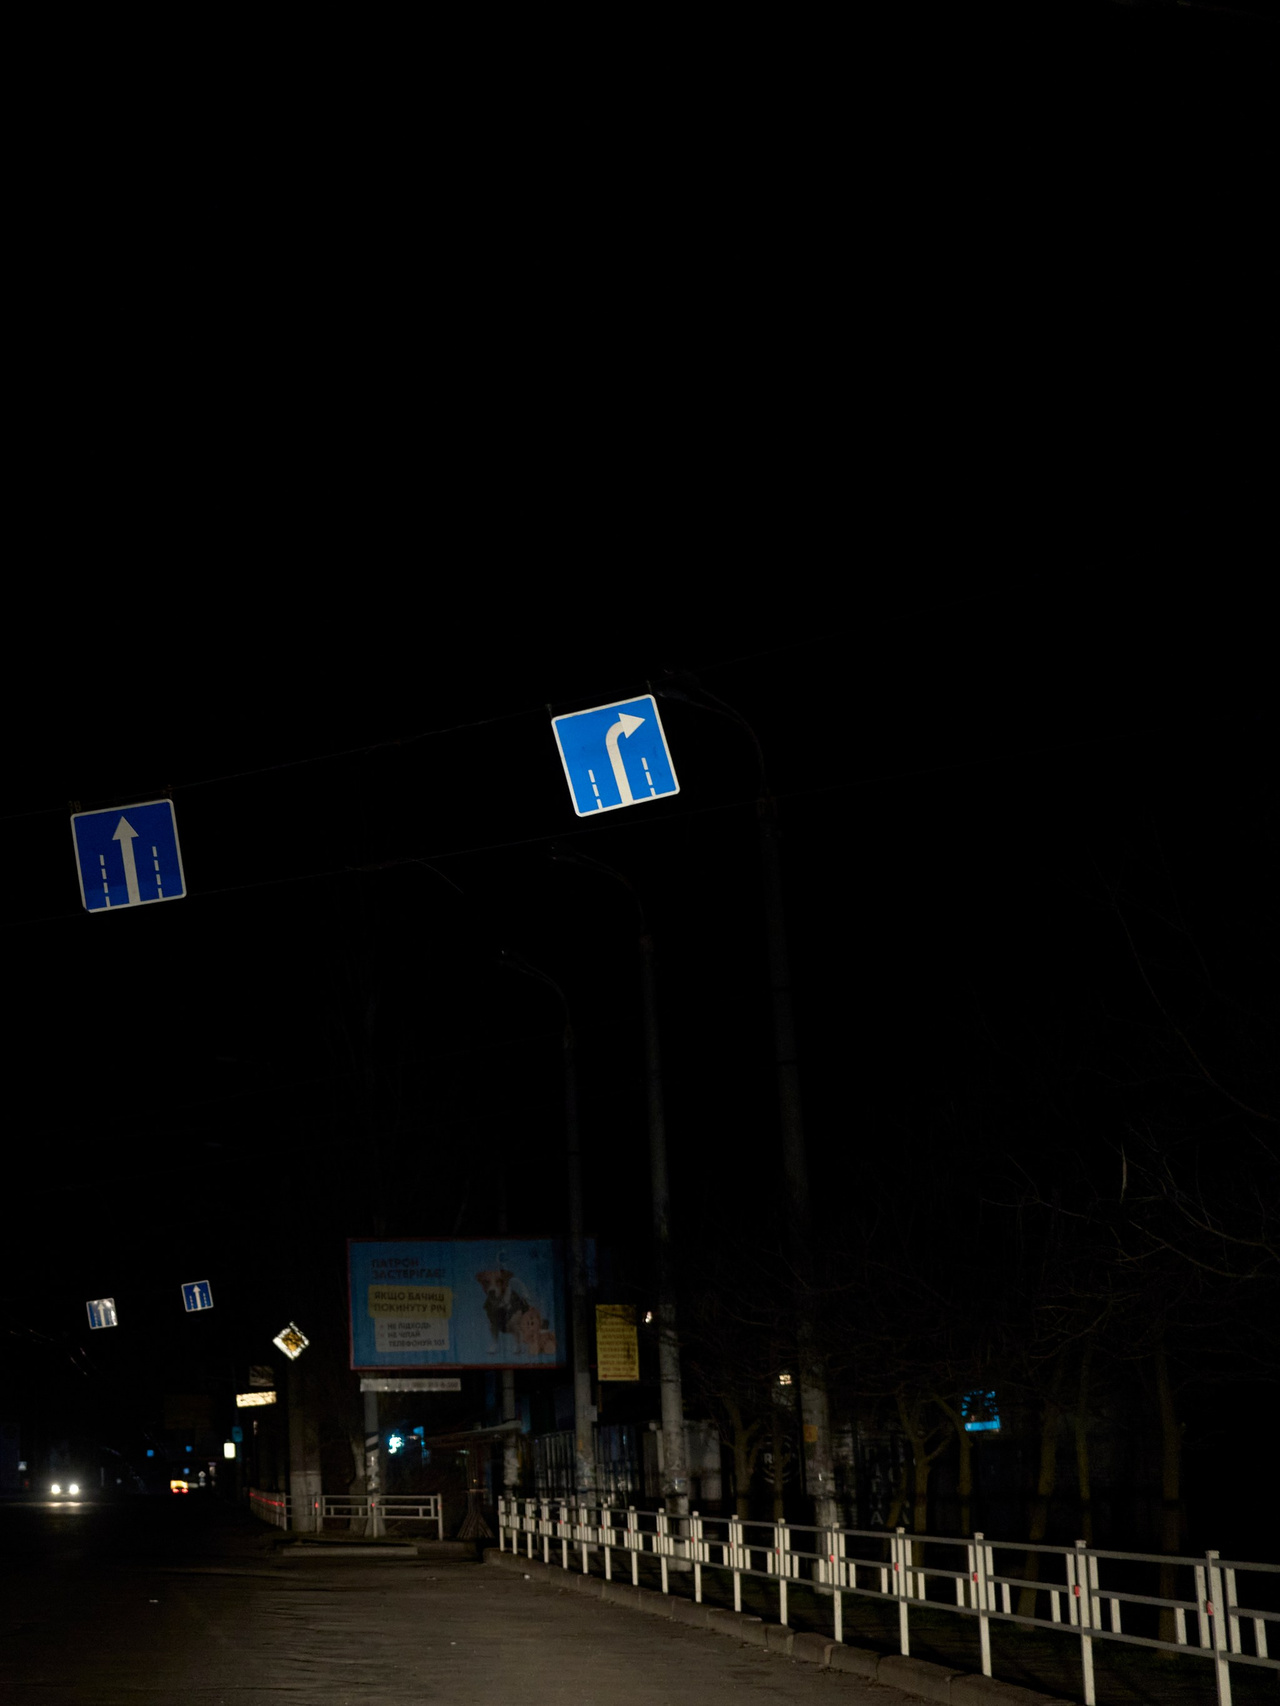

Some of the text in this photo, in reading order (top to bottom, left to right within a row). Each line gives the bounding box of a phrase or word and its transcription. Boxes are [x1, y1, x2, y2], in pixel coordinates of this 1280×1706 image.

[371, 1257, 419, 1268] ПАТРОН
[374, 1291, 445, 1302] ЯКЩО БАЧИШ
[374, 1303, 447, 1314] ПОКИНУТУ РІЧ
